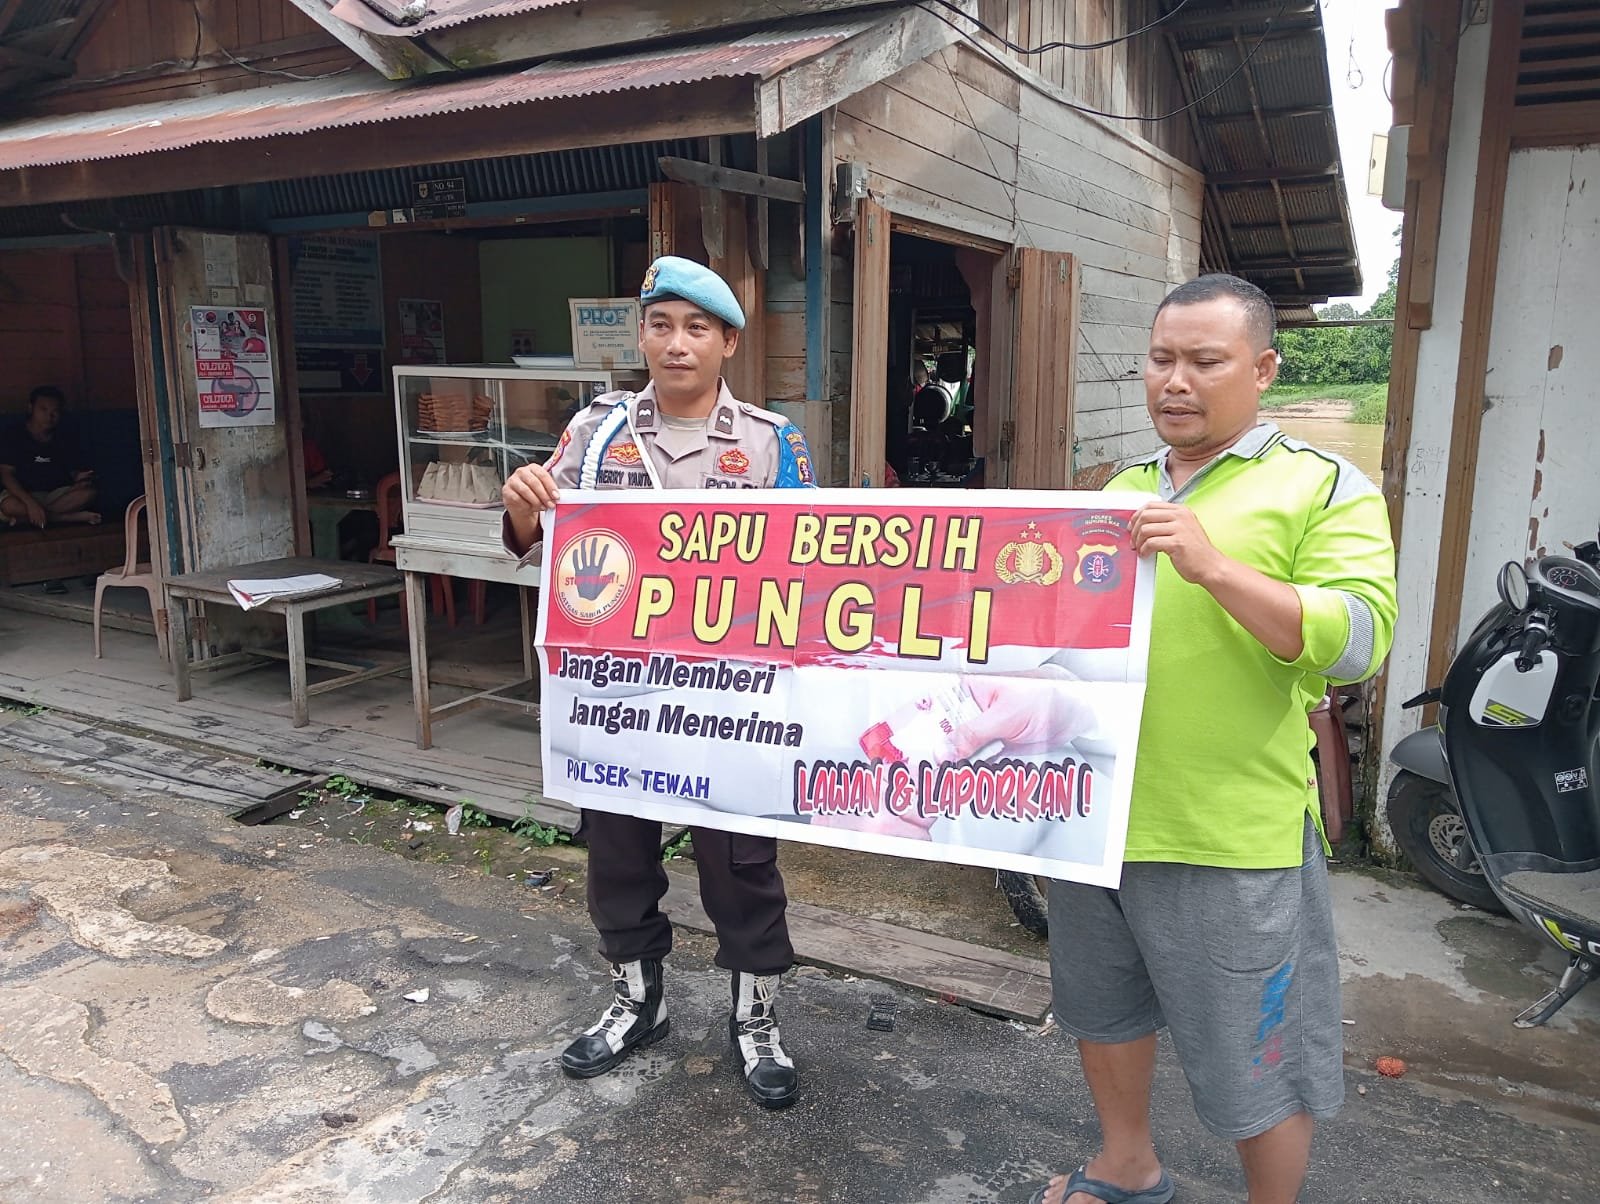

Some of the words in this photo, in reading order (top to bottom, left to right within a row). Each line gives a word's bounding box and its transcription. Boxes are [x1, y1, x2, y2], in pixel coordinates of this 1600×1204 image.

[658, 511, 768, 563] SAPU
[788, 512, 983, 572] BERSIH
[632, 575, 993, 664] PUNGLI
[558, 650, 642, 688] Jangan
[646, 656, 777, 695] Memberi
[569, 696, 651, 735] Jangan
[655, 703, 804, 748] Menerima
[566, 758, 632, 788] POLSEK
[640, 769, 711, 799] TEWAH
[794, 759, 885, 817] LAWAN
[886, 761, 915, 817] &
